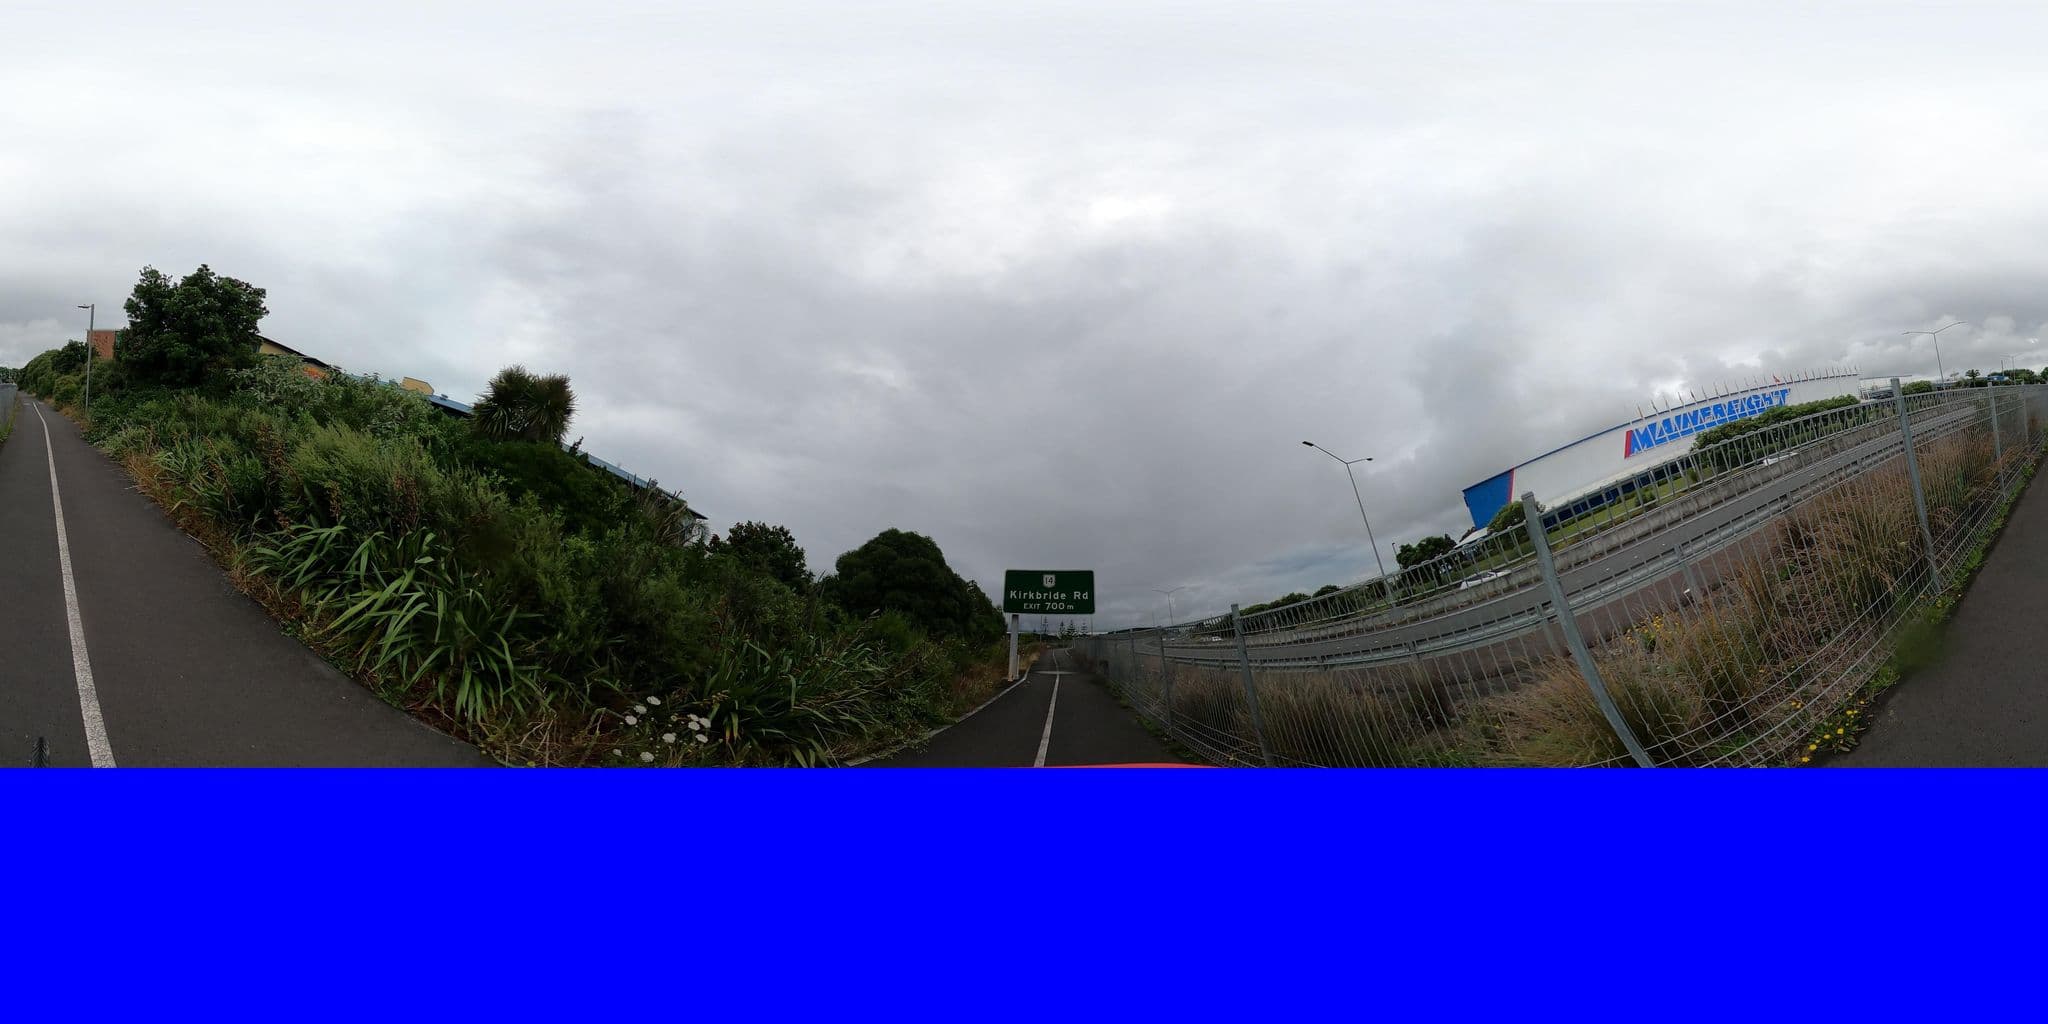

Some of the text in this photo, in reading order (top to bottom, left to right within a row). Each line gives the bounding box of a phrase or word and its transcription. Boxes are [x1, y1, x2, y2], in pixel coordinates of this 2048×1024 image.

[1045, 576, 1053, 584] 14
[1010, 590, 1089, 600] Kirkbride Rd
[1023, 602, 1041, 610] EXIT
[1045, 602, 1065, 610] 700
